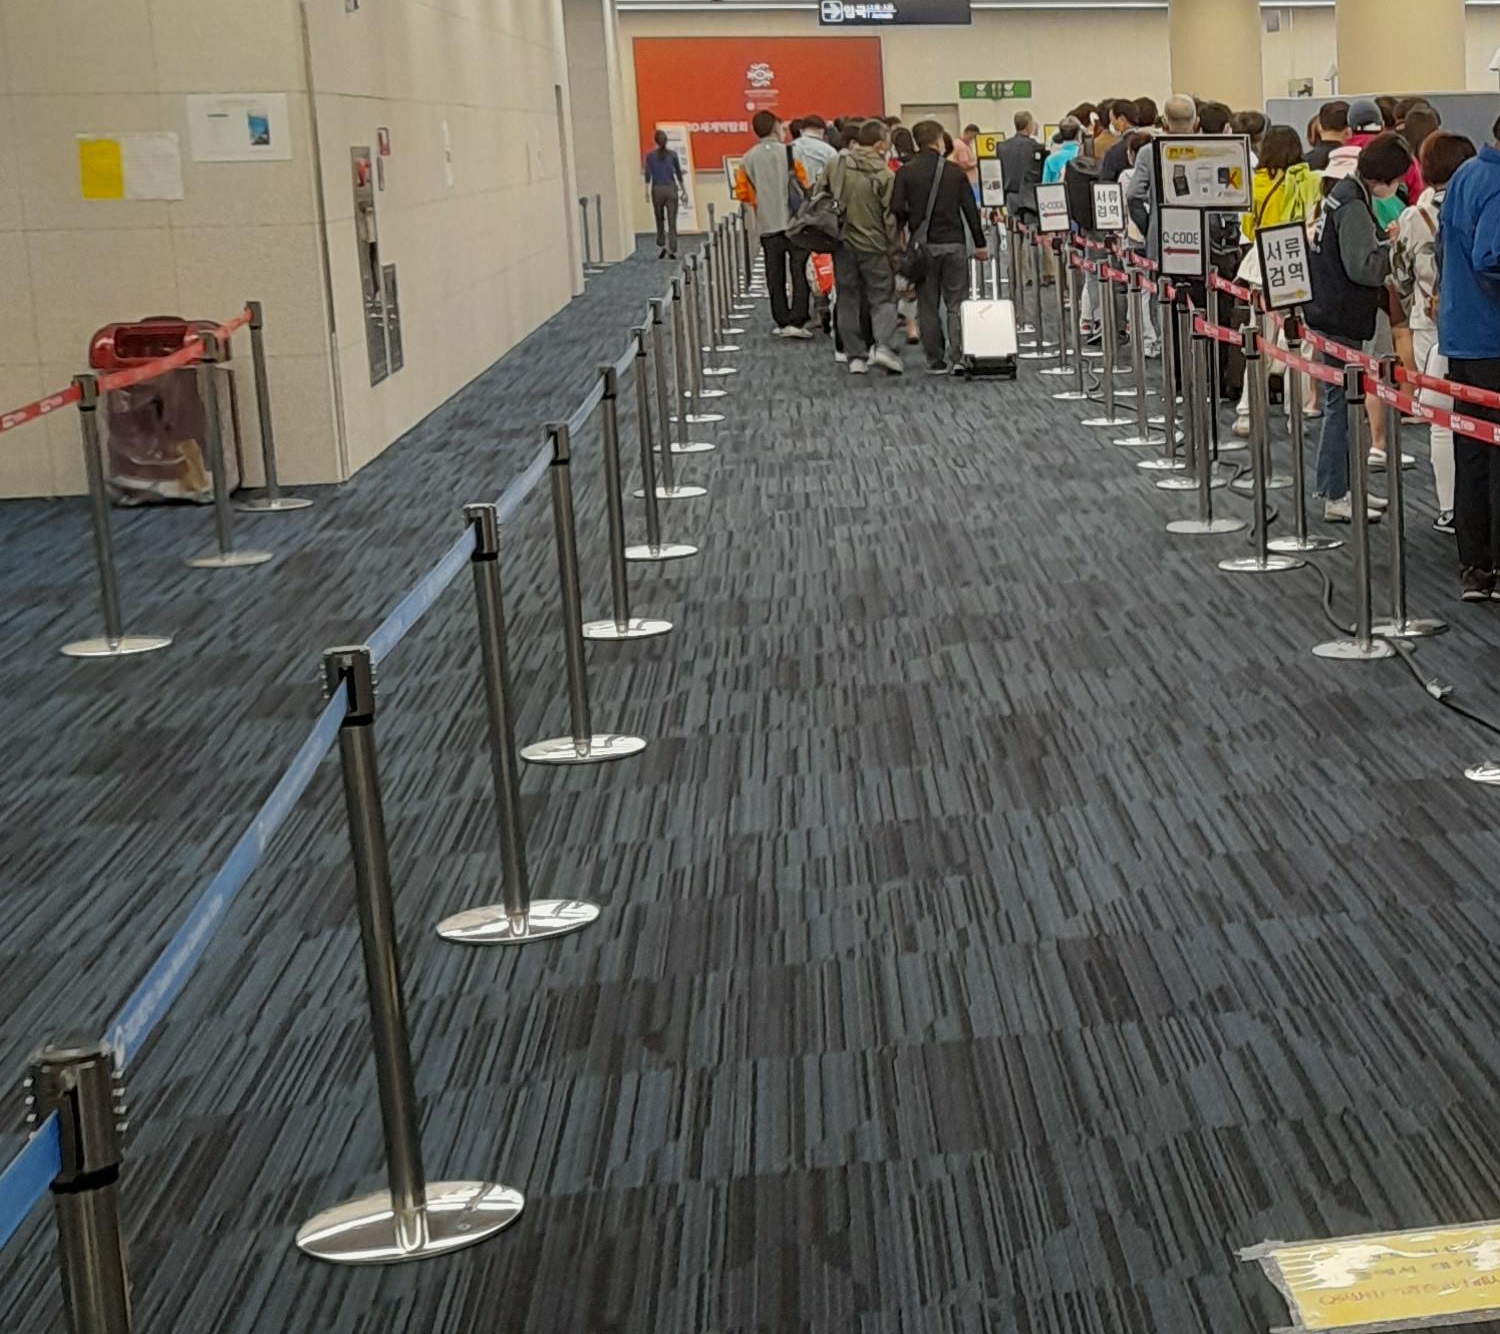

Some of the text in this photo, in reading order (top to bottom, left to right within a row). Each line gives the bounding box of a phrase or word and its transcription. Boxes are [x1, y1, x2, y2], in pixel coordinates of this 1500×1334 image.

[985, 137, 996, 152] 6
[1097, 190, 1118, 203] 서류
[1097, 205, 1119, 218] 검역
[1162, 231, 1199, 244] Q-CODE
[1266, 237, 1301, 261] 서류
[1268, 262, 1305, 288] 검역
